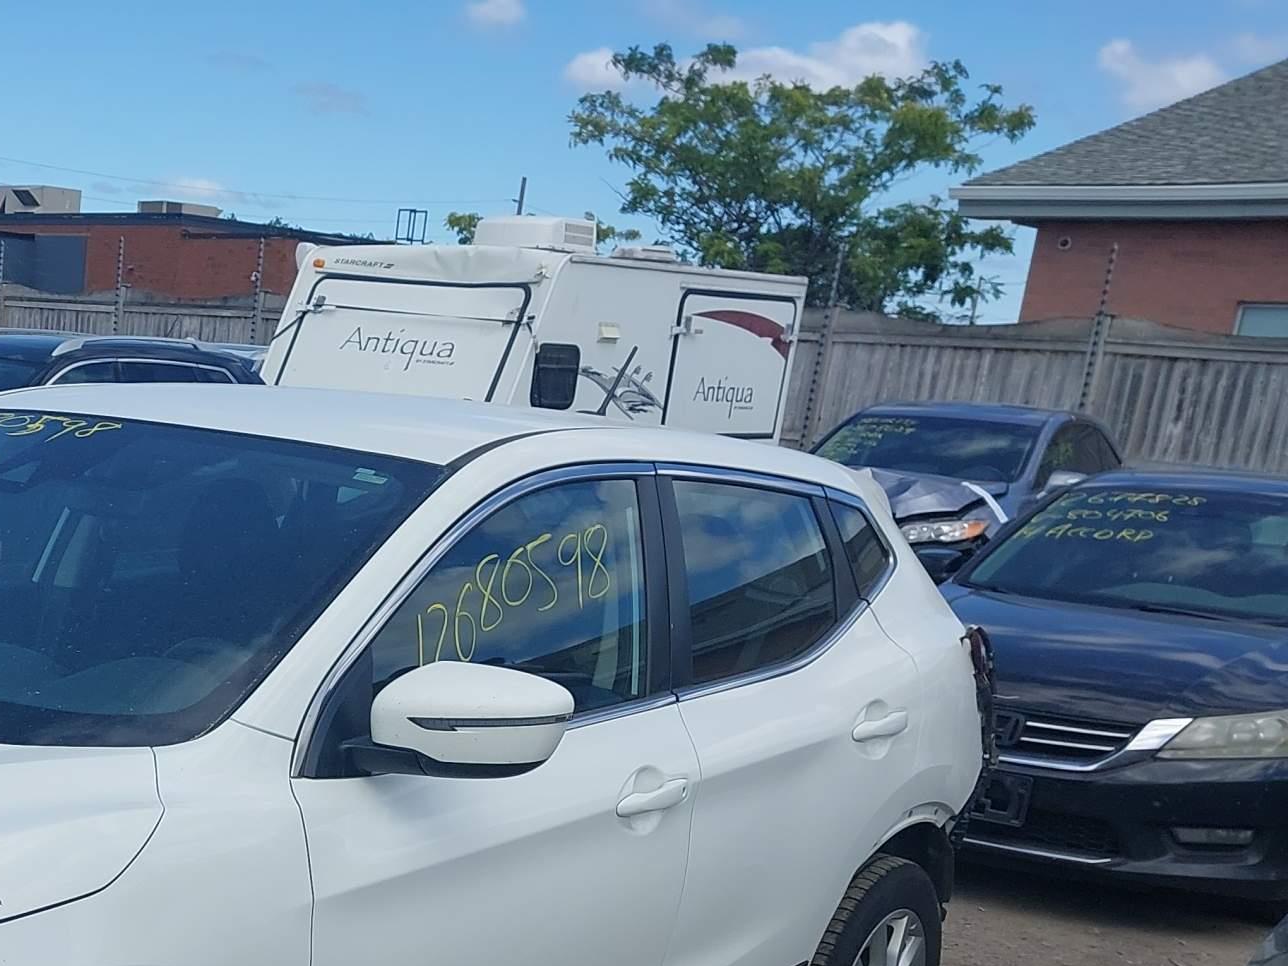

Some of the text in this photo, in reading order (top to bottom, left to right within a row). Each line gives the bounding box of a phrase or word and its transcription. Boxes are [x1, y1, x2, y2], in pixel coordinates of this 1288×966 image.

[334, 258, 384, 269] STARCRAFT
[339, 326, 455, 371] Antiqua
[693, 376, 753, 419] Antiqua
[417, 523, 611, 667] 12680598
